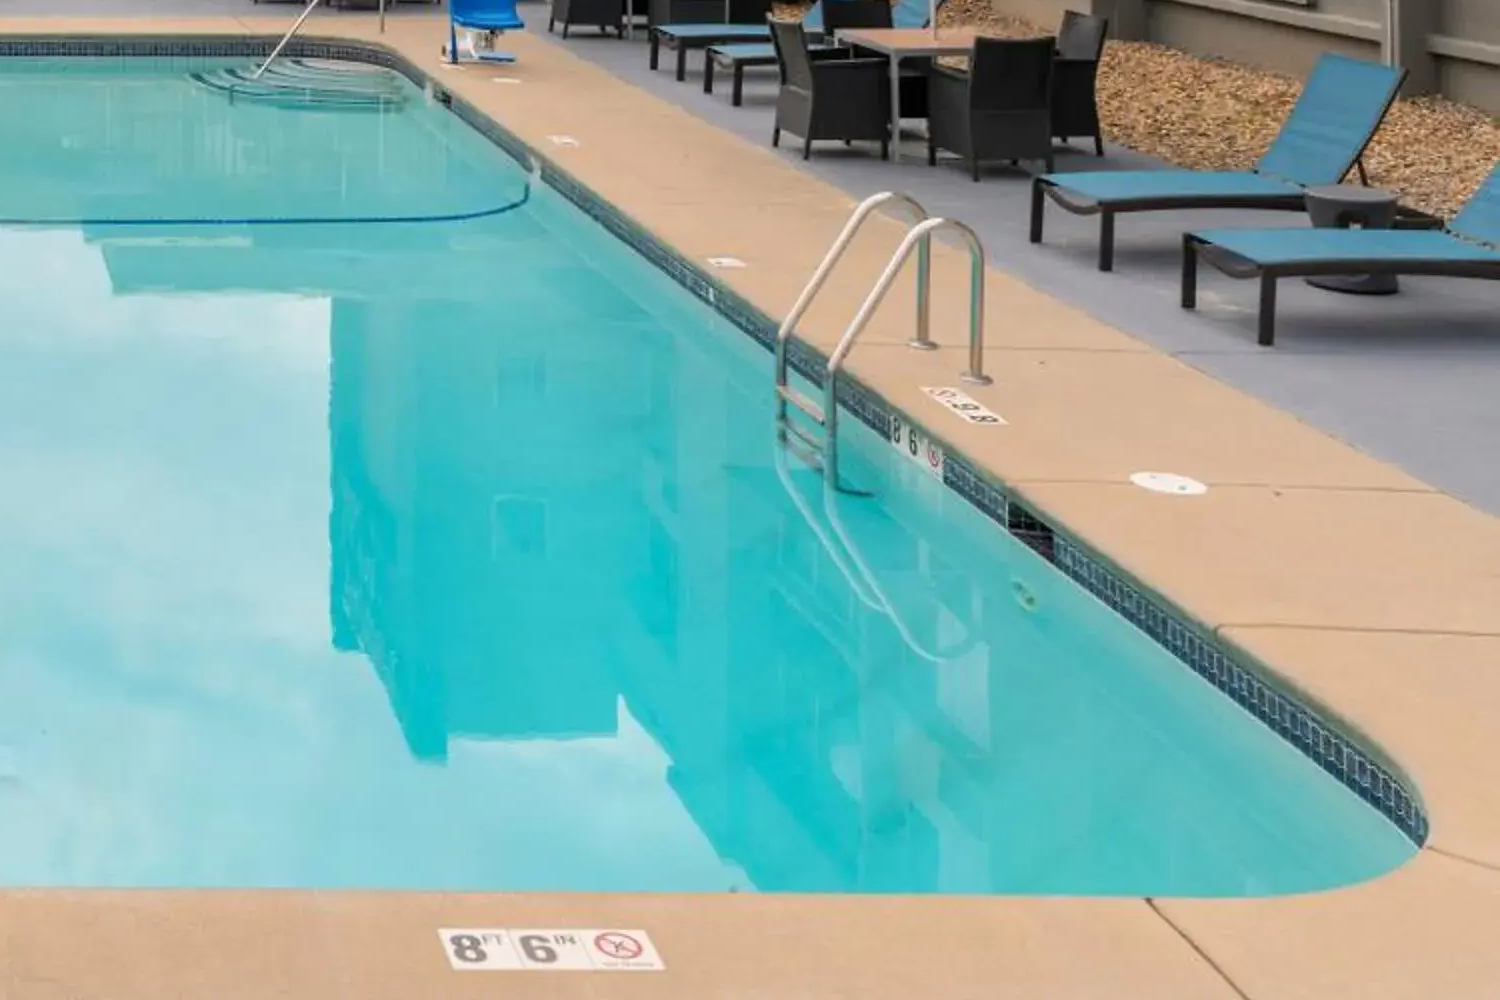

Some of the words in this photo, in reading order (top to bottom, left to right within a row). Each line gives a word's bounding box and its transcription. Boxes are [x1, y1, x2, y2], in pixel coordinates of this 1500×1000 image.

[909, 429, 918, 456] 6
[449, 934, 488, 963] 8
[519, 935, 558, 964] 6
[554, 935, 577, 946] IN
